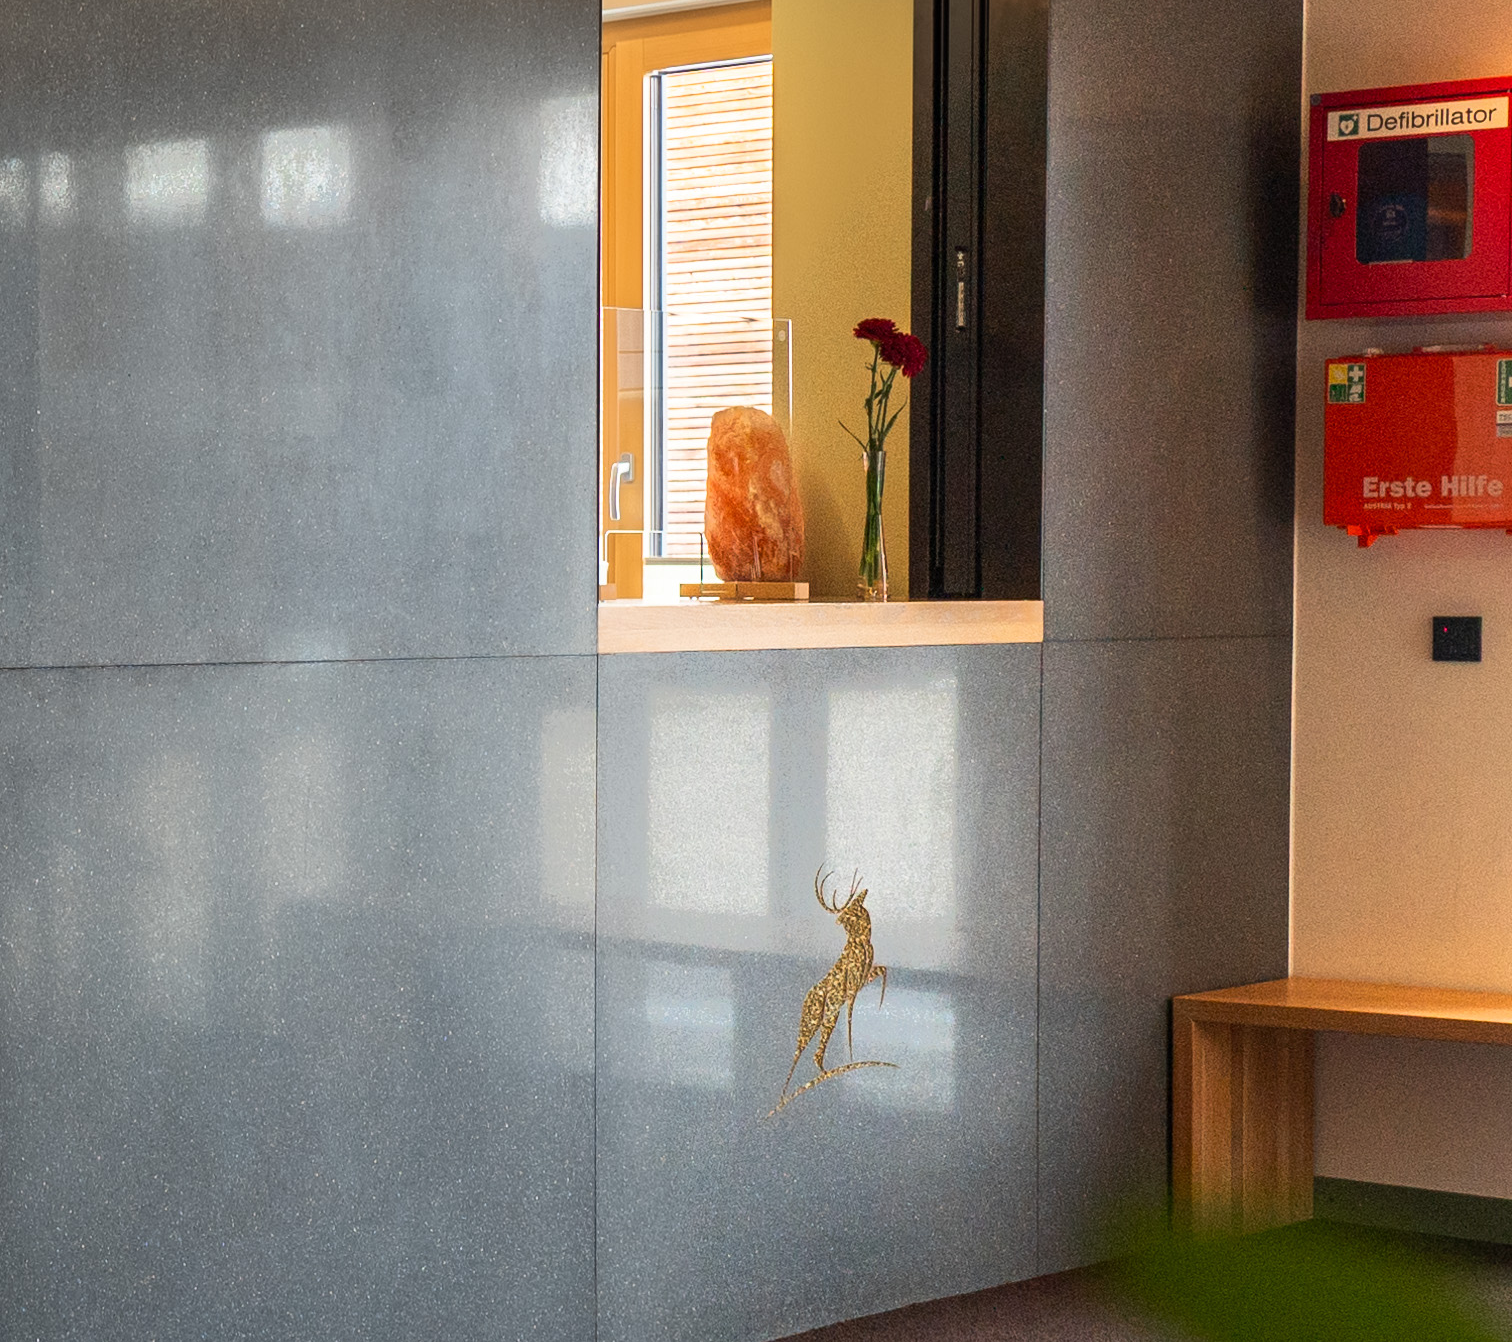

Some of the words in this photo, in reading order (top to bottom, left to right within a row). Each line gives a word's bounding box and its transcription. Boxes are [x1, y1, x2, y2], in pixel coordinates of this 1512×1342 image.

[1366, 104, 1498, 133] Defibrillator
[1363, 476, 1433, 498] Erste
[1440, 475, 1504, 498] Hilfe
